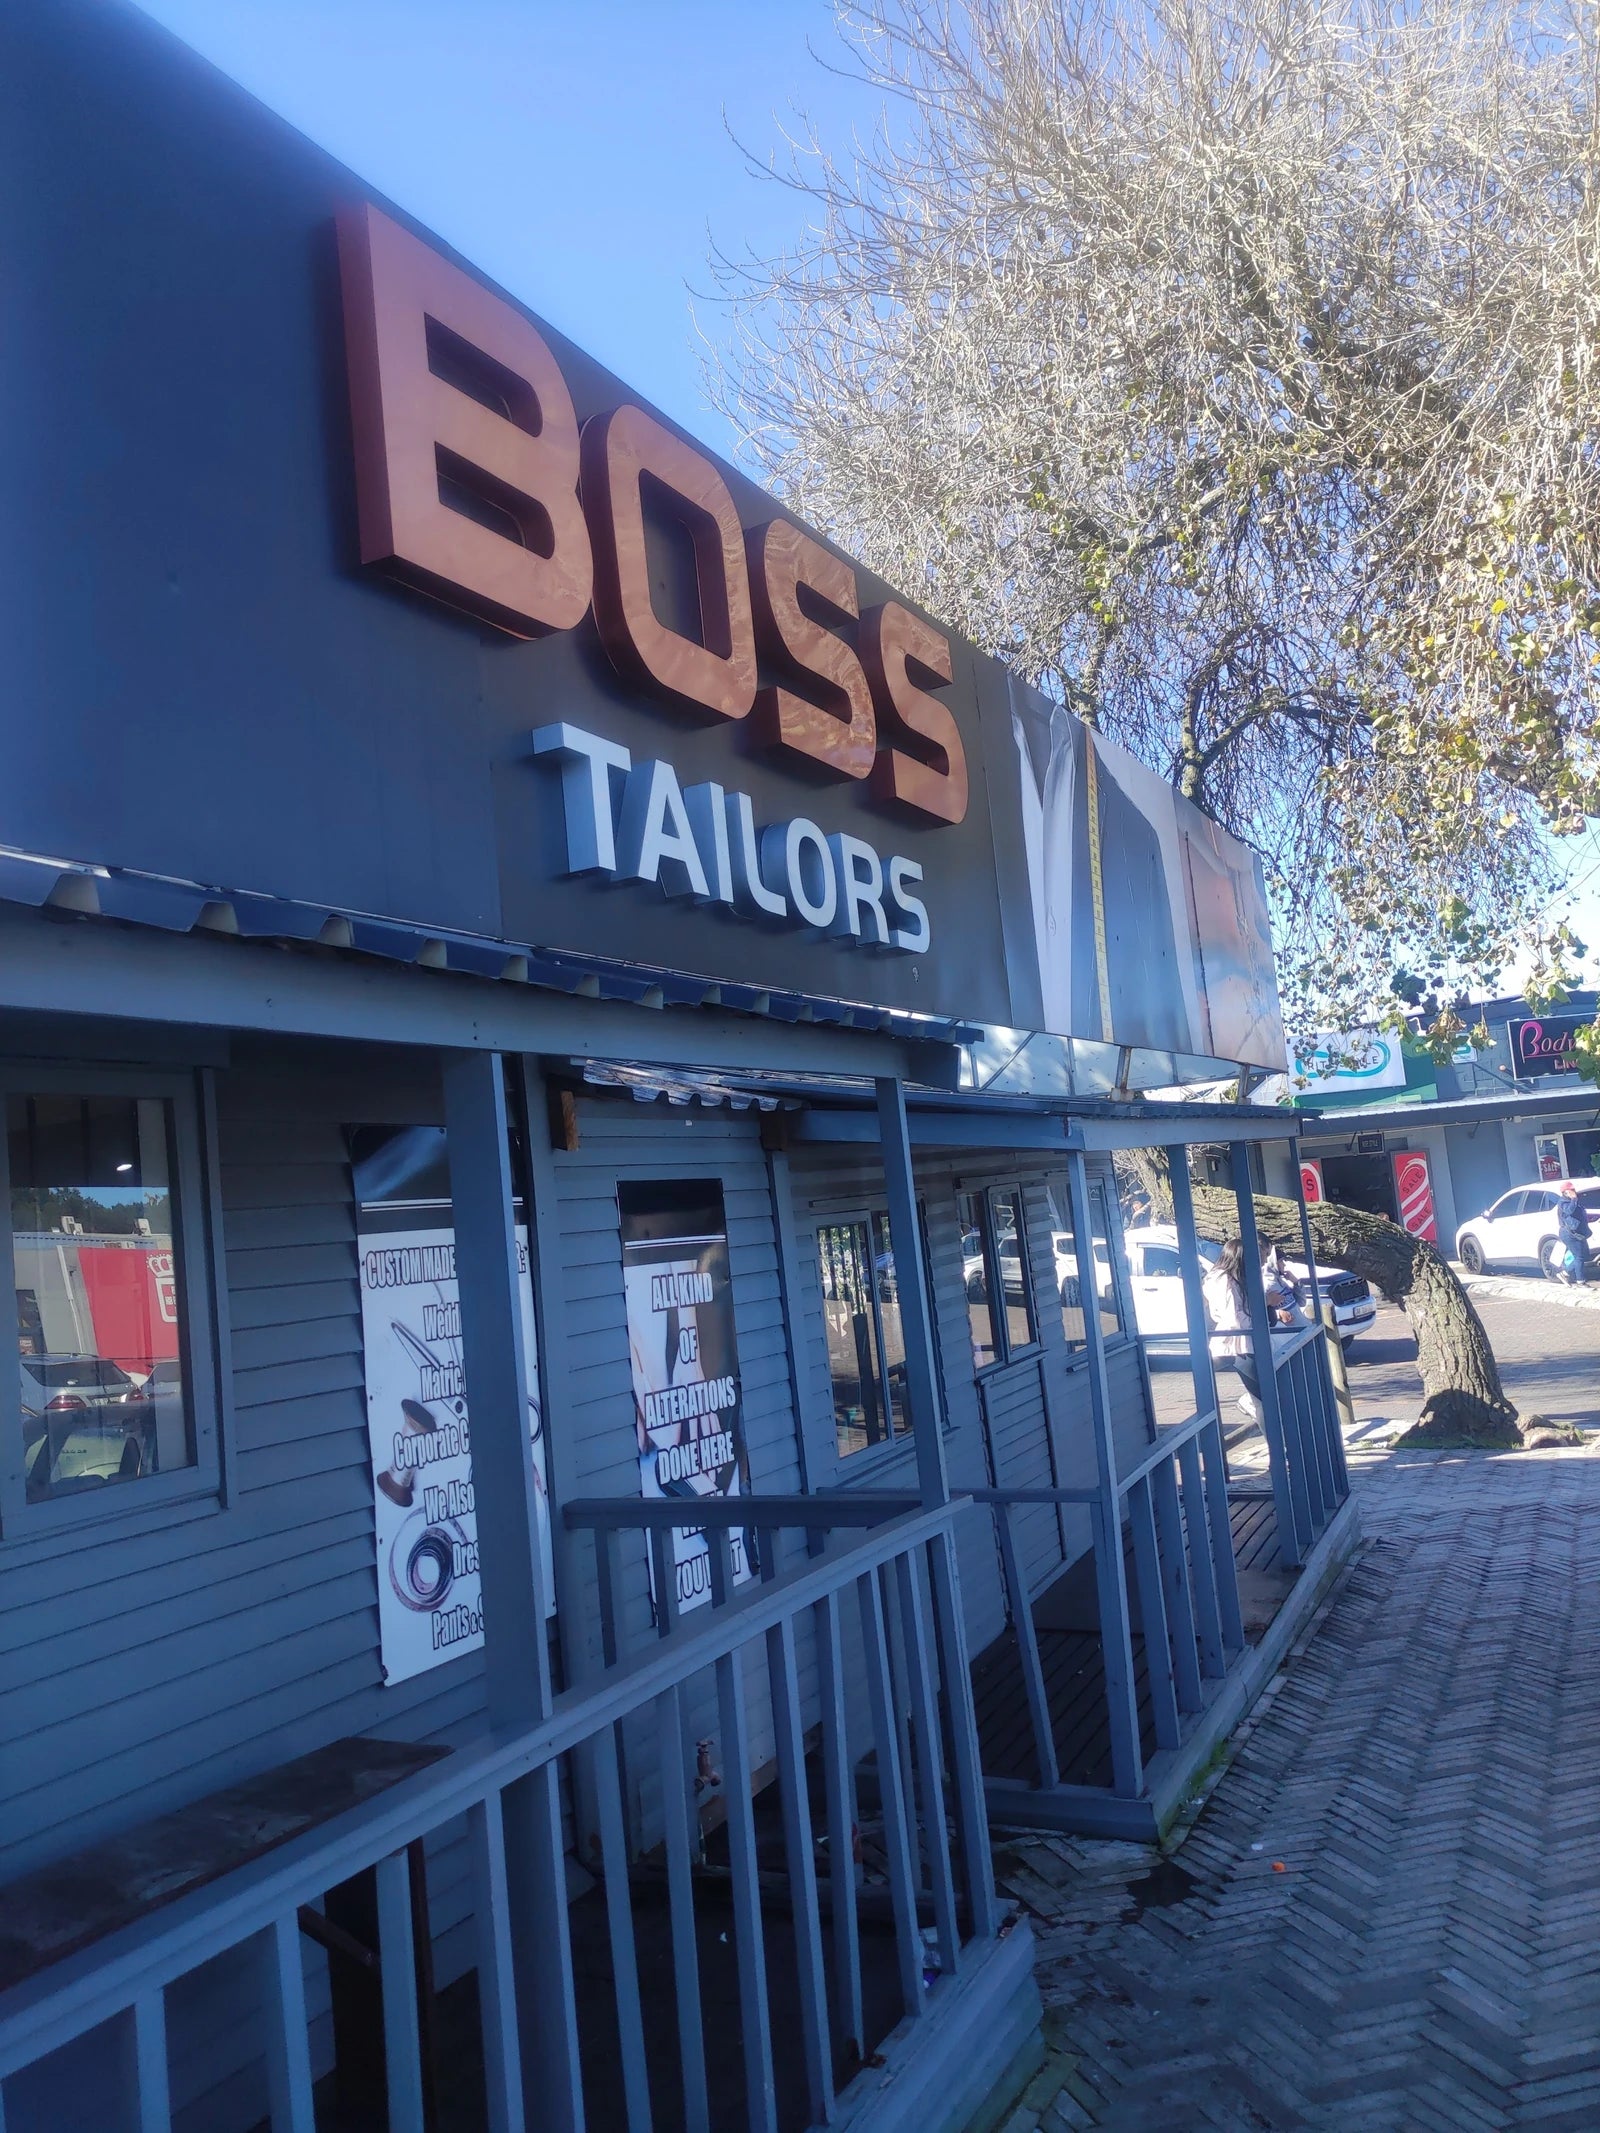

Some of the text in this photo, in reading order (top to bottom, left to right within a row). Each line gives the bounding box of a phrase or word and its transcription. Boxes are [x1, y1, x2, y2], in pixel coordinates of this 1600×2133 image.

[336, 203, 968, 826] BOSS
[533, 722, 931, 955] TAILORS
[1402, 1172, 1423, 1194] SALE
[1411, 1207, 1432, 1229] SALE
[366, 1244, 457, 1289] CUSTOM MADE
[651, 1272, 714, 1312] ALL KIND
[423, 1302, 463, 1341] Wedd
[678, 1326, 698, 1364] OF
[420, 1361, 463, 1403] Matric
[644, 1375, 737, 1430] ALTERATIONS
[393, 1424, 459, 1471] Corporate
[657, 1430, 735, 1486] DONE HERE
[423, 1479, 475, 1526] We Also
[452, 1540, 480, 1579] Dres
[432, 1604, 470, 1650] Pants
[470, 1612, 478, 1634] &
